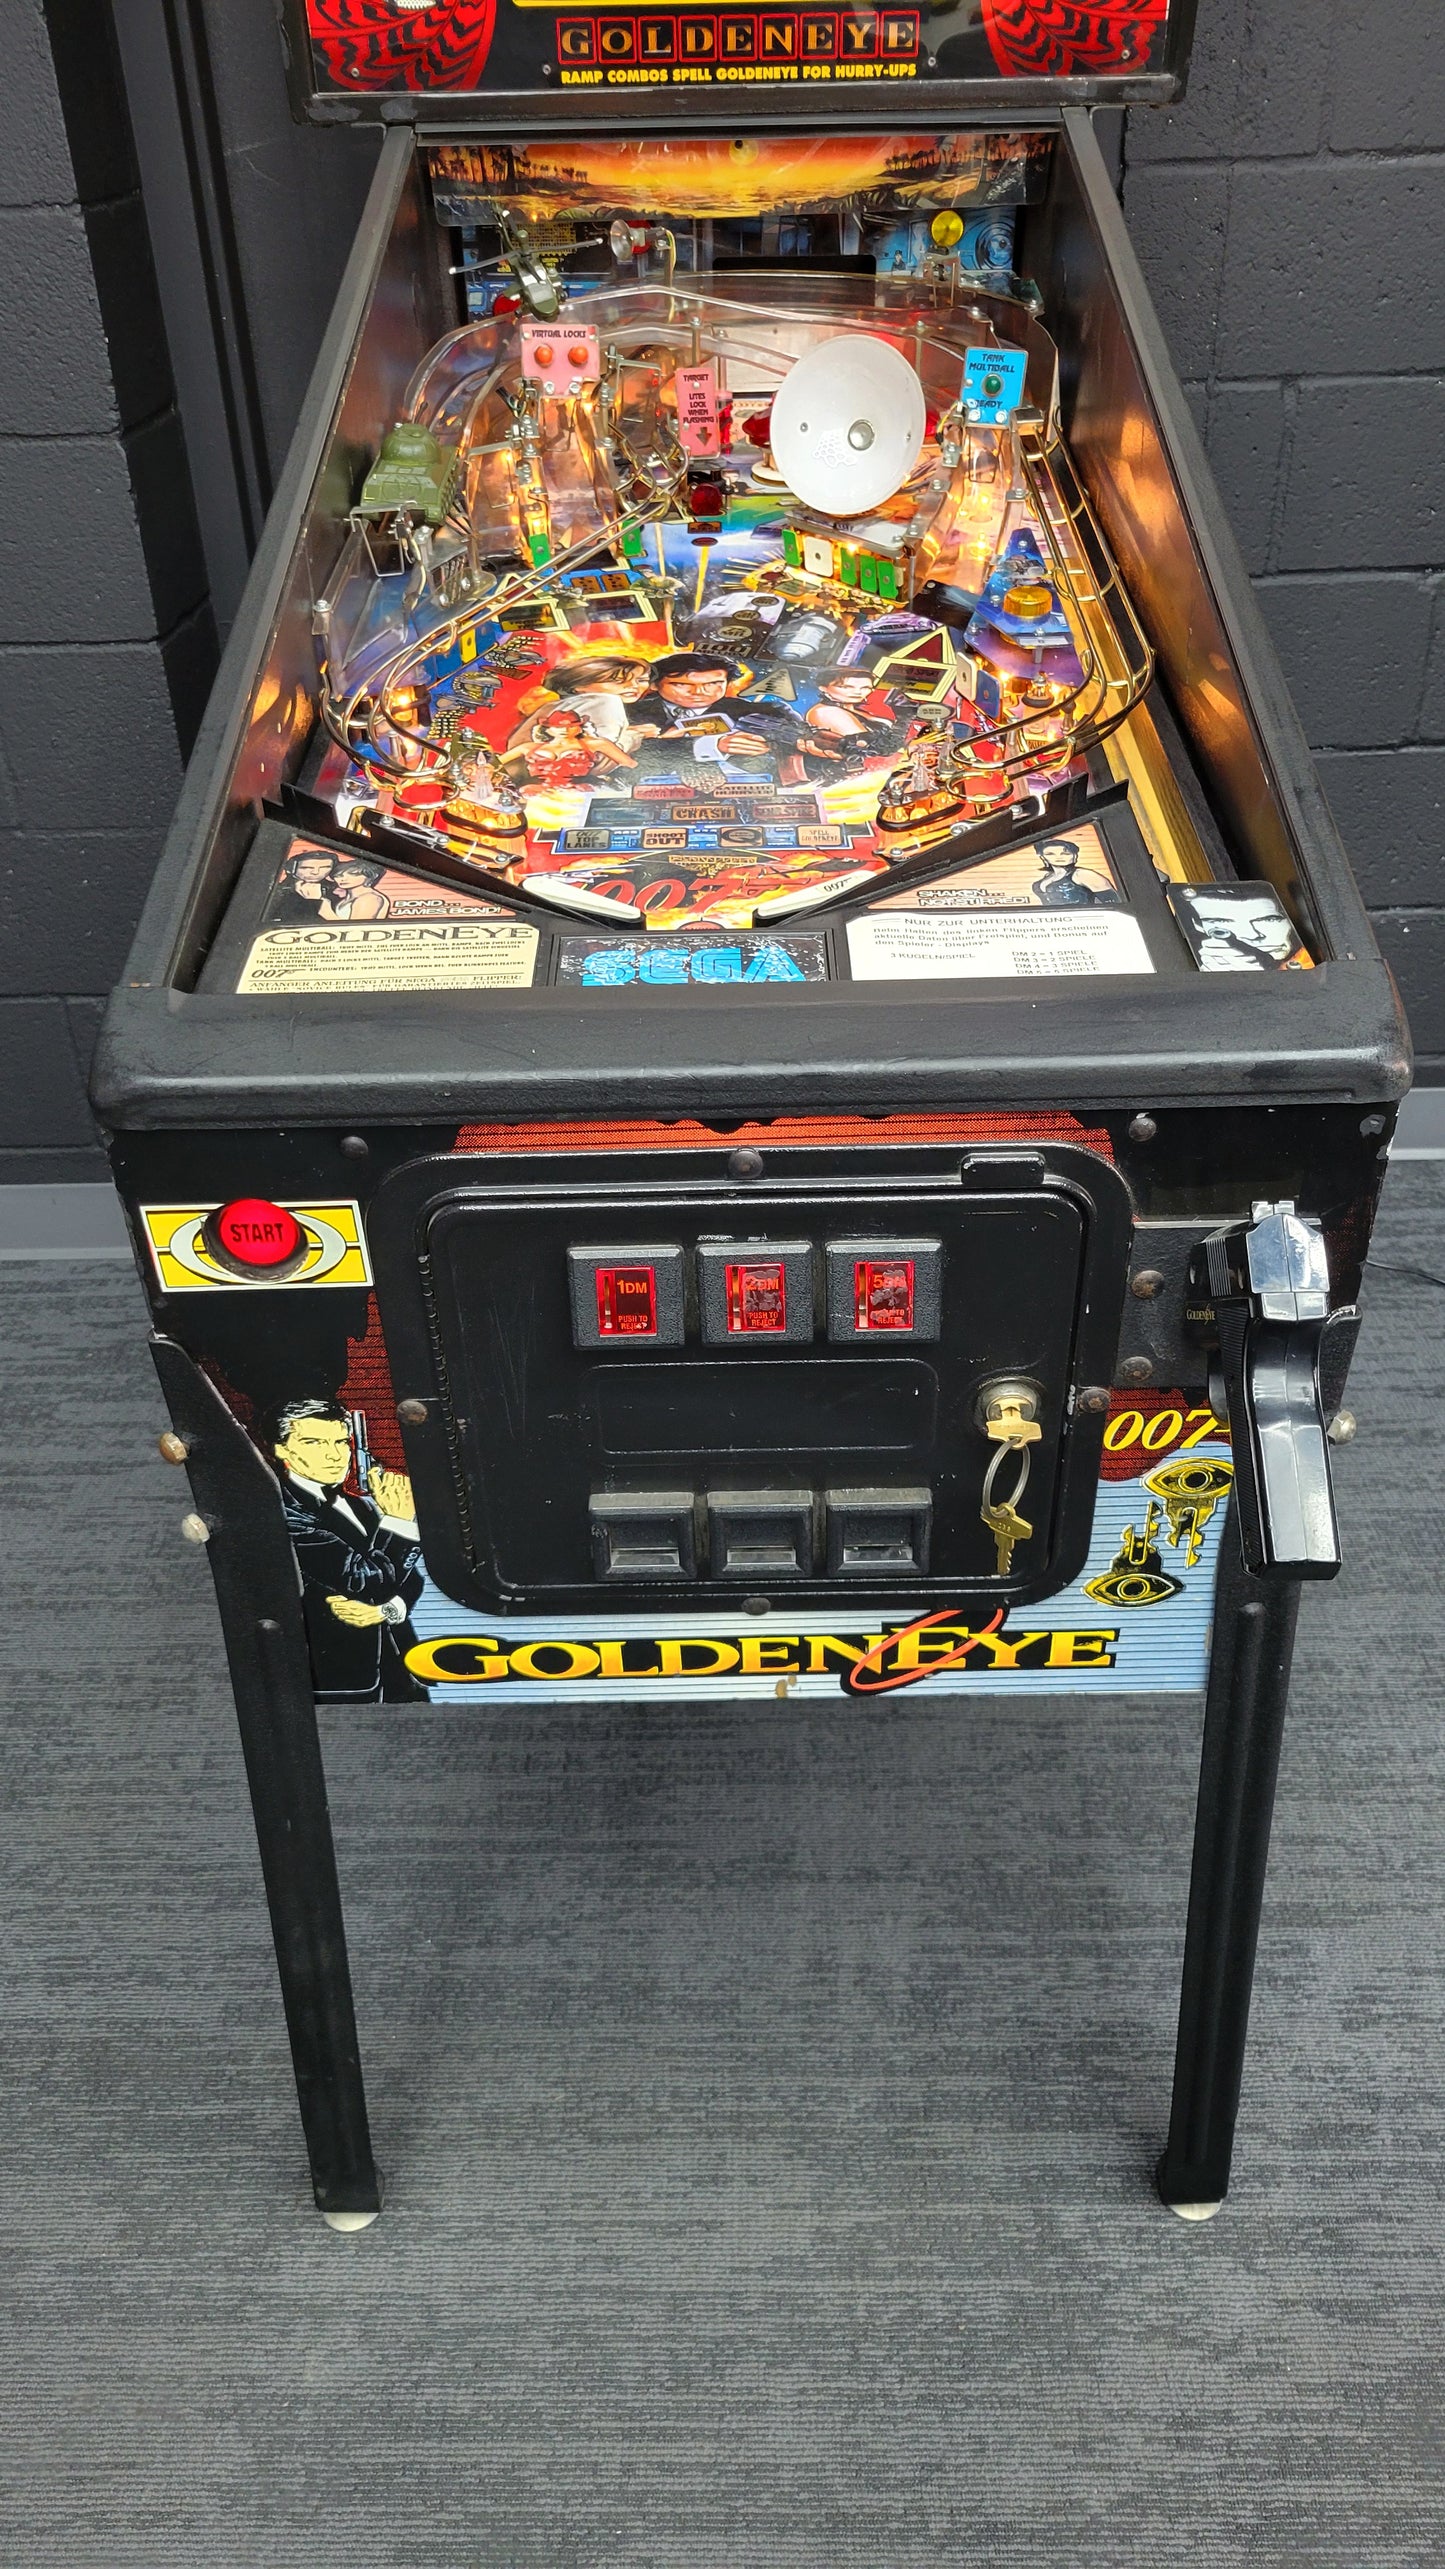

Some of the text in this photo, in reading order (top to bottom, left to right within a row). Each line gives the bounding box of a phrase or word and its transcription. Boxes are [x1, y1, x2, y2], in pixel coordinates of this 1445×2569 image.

[562, 21, 914, 55] GOLDENEYE
[561, 64, 917, 84] RAMP COMBOS SPELL GOLDENEYE FOR HURRY-UPS
[532, 330, 586, 338] VIRTUAL LOCKS
[982, 353, 1005, 362] TANK
[969, 362, 1015, 373] MULTIBALL
[683, 374, 709, 382] TARGET
[683, 416, 714, 424] FLASHING
[676, 808, 731, 819] CRASH
[646, 838, 685, 846] OUT
[823, 879, 847, 893] 007
[392, 906, 502, 916] JAMES BOND!
[904, 918, 932, 926] NUR
[969, 917, 1073, 925] UNTERHALTUNG
[945, 940, 990, 948] Displays
[582, 946, 807, 987] SEGA
[230, 1222, 284, 1243] START
[617, 1279, 648, 1294] 1DM
[618, 1315, 637, 1323] PUSH
[749, 1311, 779, 1319] PUSH TO
[751, 1318, 776, 1327] REJECT
[1103, 1409, 1220, 1451] 007
[404, 1626, 1118, 1682] GOLDENEYE
